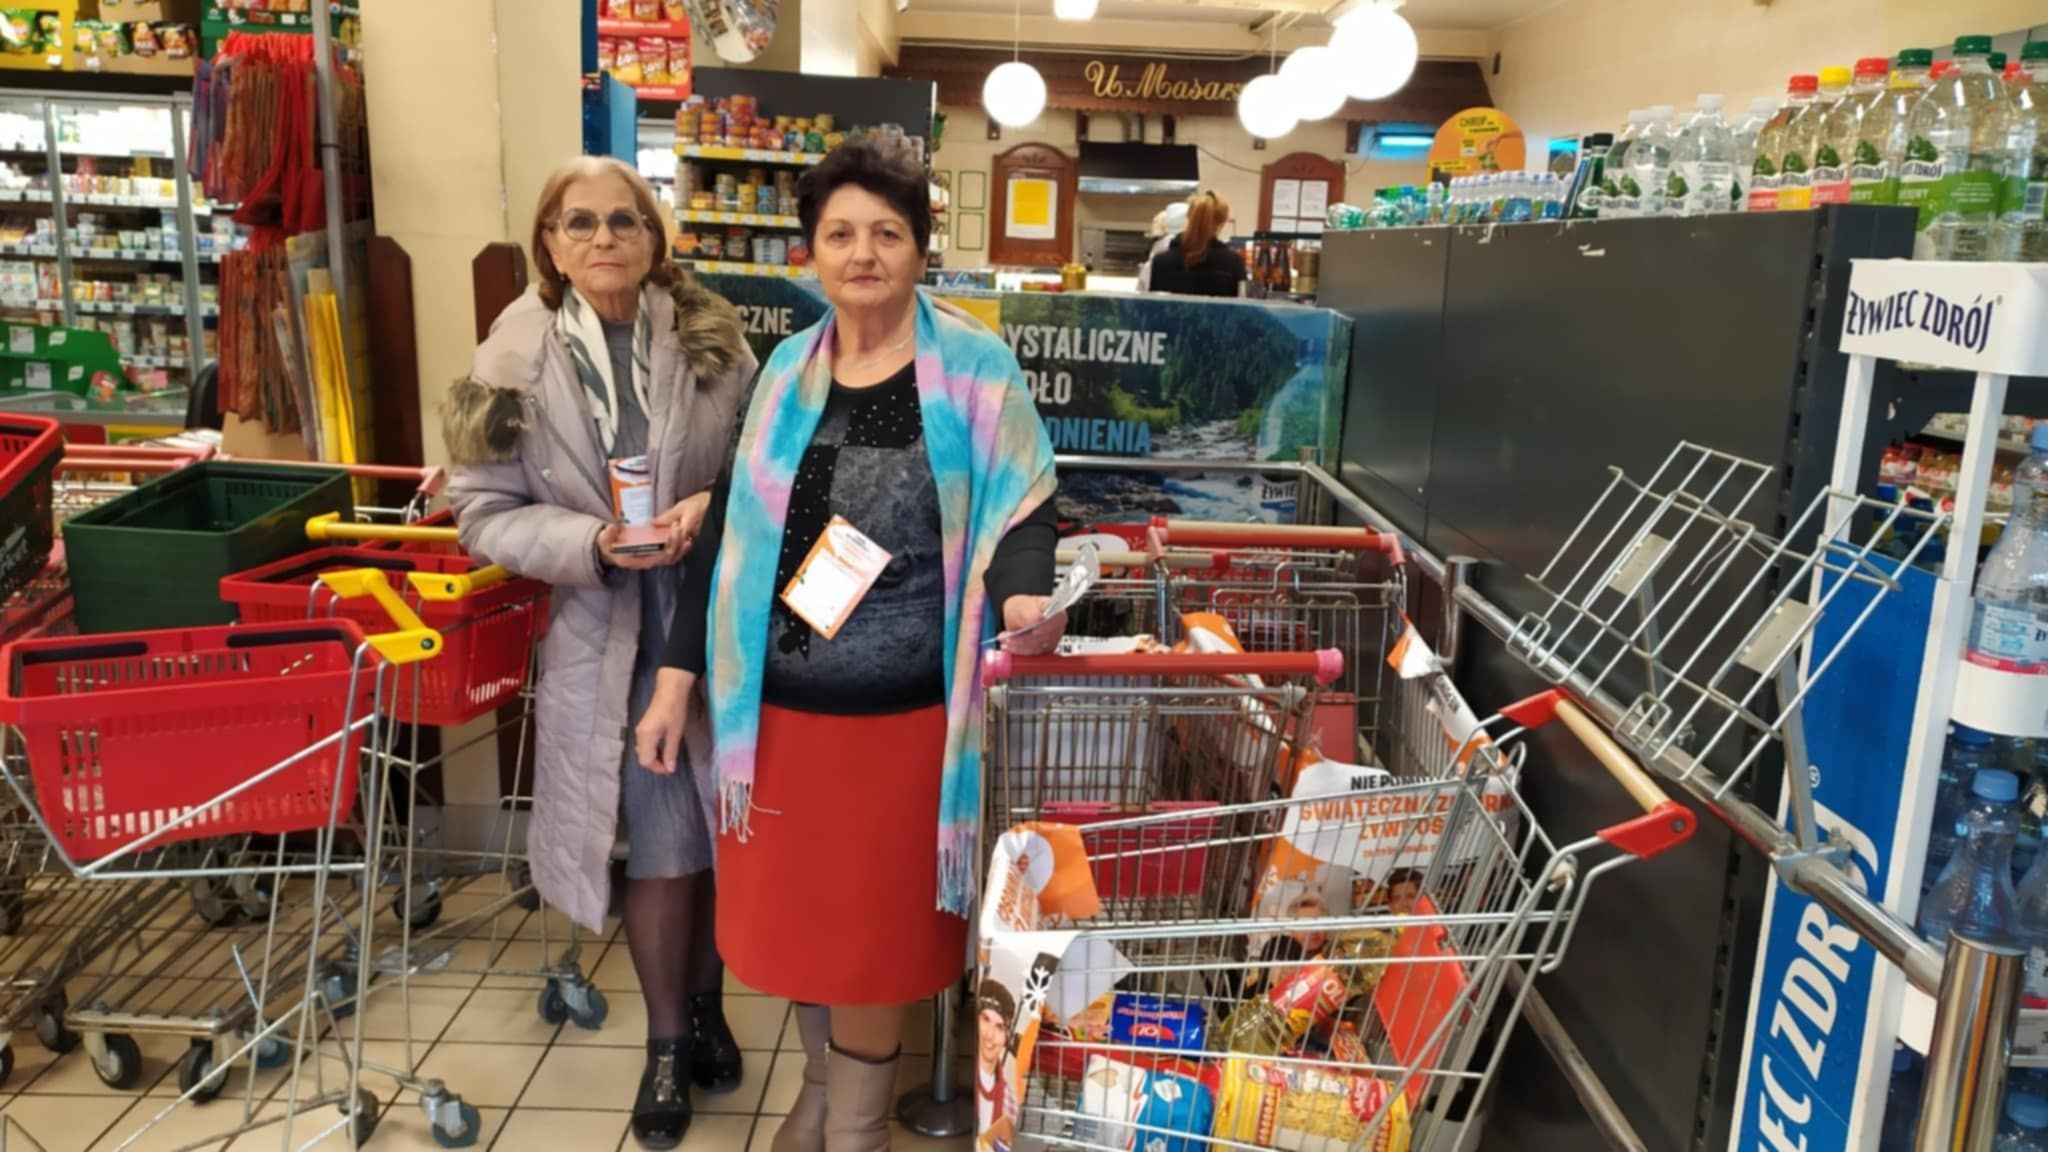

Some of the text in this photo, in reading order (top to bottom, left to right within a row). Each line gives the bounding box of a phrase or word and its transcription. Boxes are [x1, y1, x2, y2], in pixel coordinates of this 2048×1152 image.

[738, 304, 794, 336] CZNE
[1845, 289, 1995, 355] ŻYWIEC ZDRÓJ
[1001, 324, 1168, 365] YSTALICZNE
[1045, 416, 1153, 454] DNIENIA
